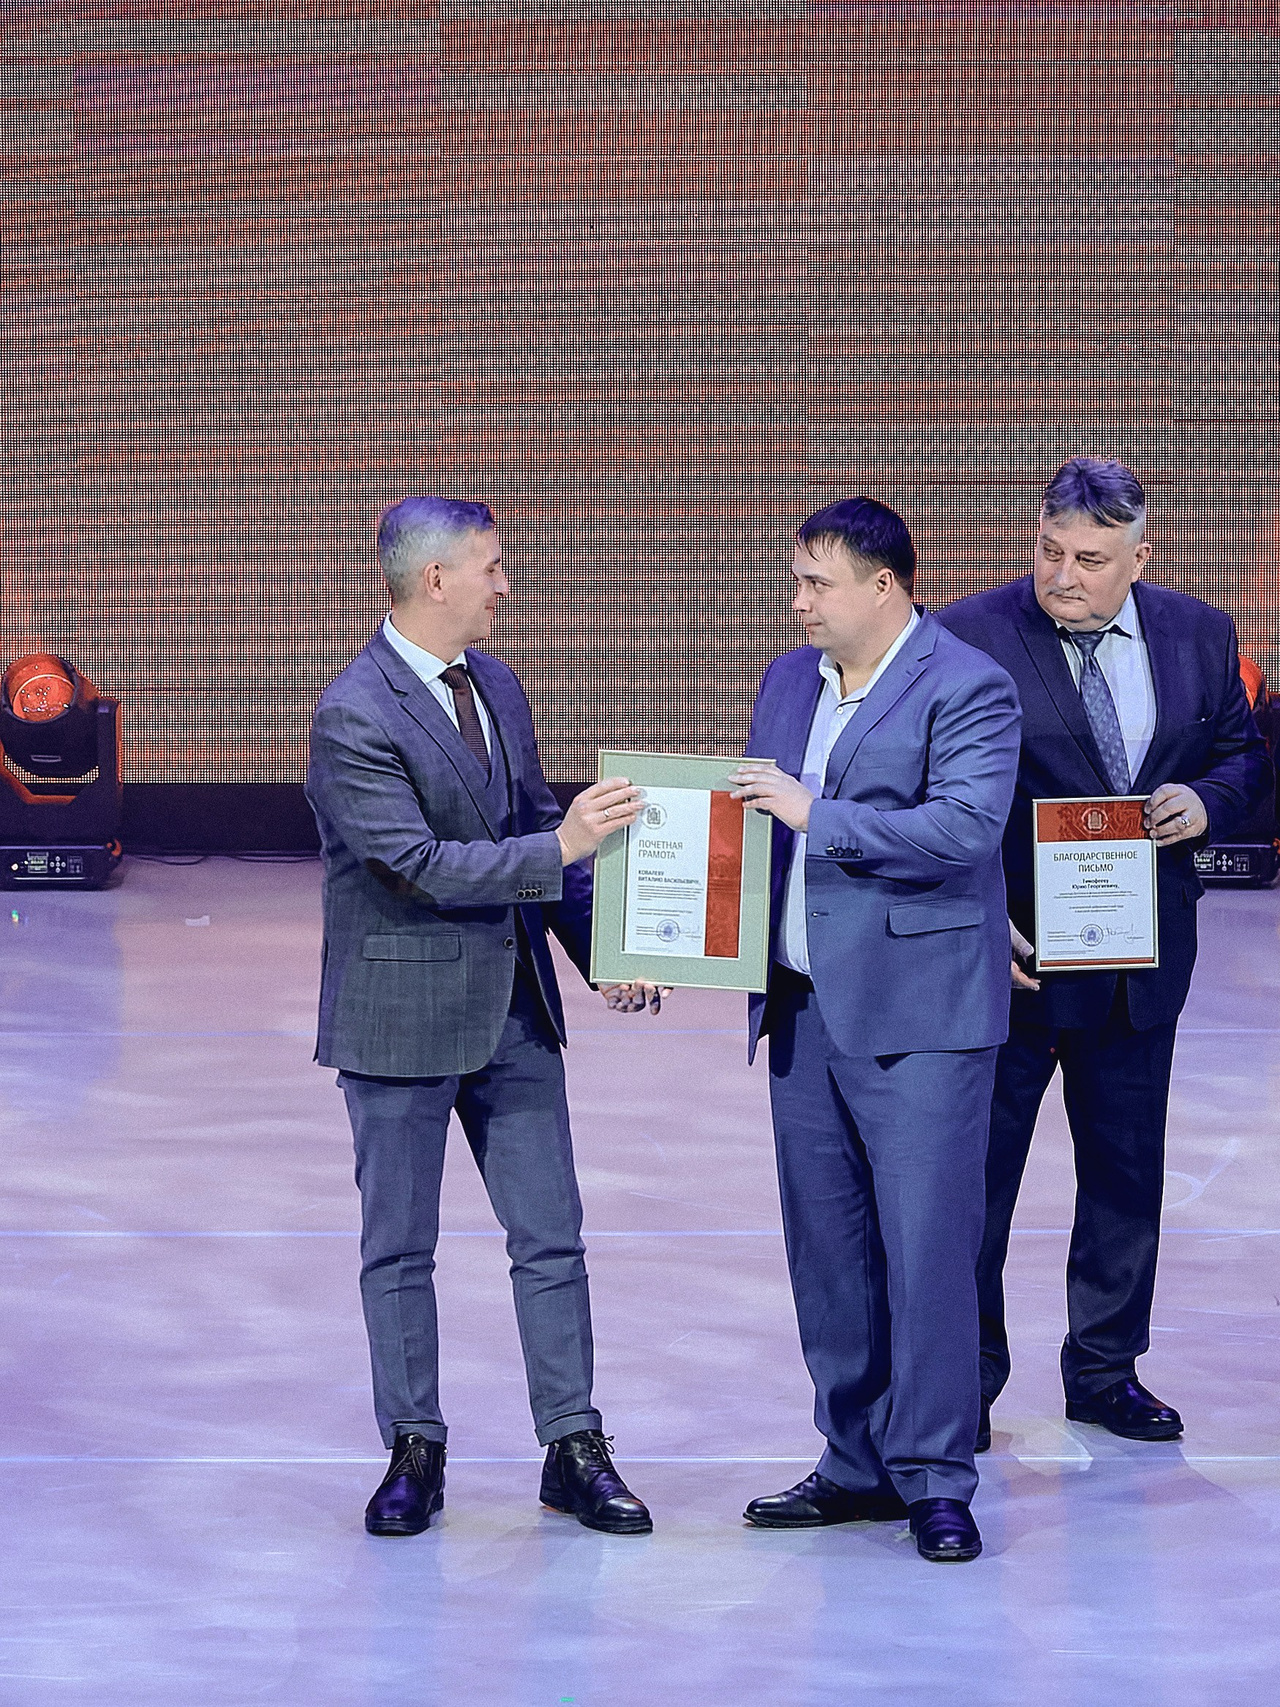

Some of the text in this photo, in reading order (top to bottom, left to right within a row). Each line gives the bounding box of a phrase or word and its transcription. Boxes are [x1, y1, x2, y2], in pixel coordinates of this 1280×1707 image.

[638, 839, 684, 850] ПОЧЕТНАЯ
[638, 849, 676, 860] ГРАМОТА
[1053, 850, 1138, 862] БЛАГОДАРСТВЕННОЕ
[1078, 863, 1114, 873] ПИСЬМО
